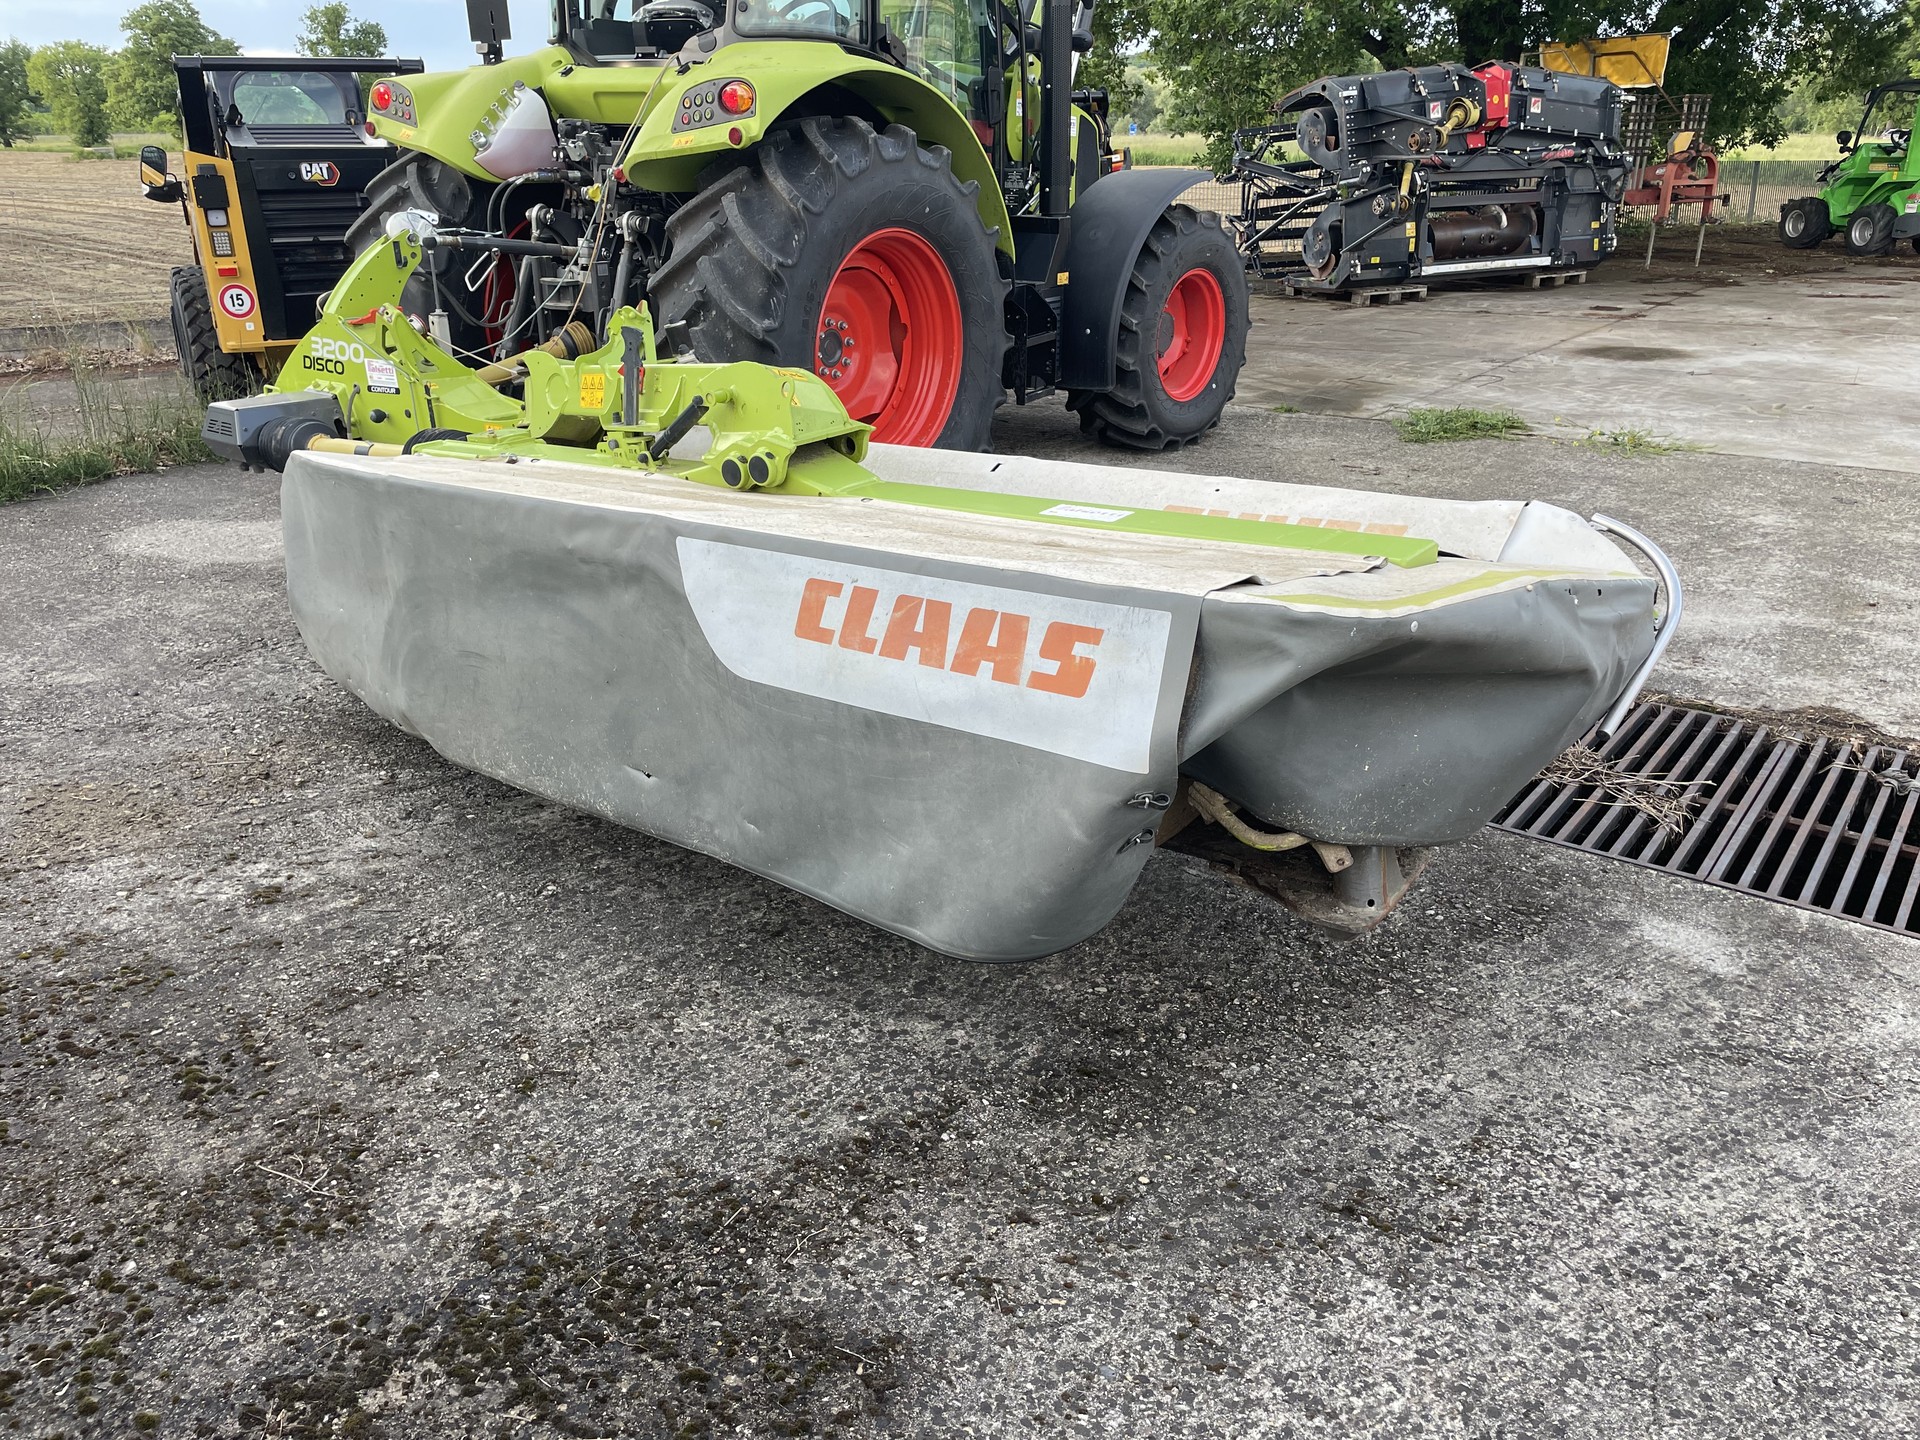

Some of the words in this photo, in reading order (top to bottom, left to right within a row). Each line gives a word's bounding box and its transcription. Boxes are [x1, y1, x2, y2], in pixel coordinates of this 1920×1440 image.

[301, 163, 329, 180] CAT
[229, 293, 245, 307] 15
[310, 336, 365, 364] 3200
[303, 355, 345, 375] DISCO
[370, 386, 396, 394] CONTOUR
[794, 577, 1105, 699] CLAAS
